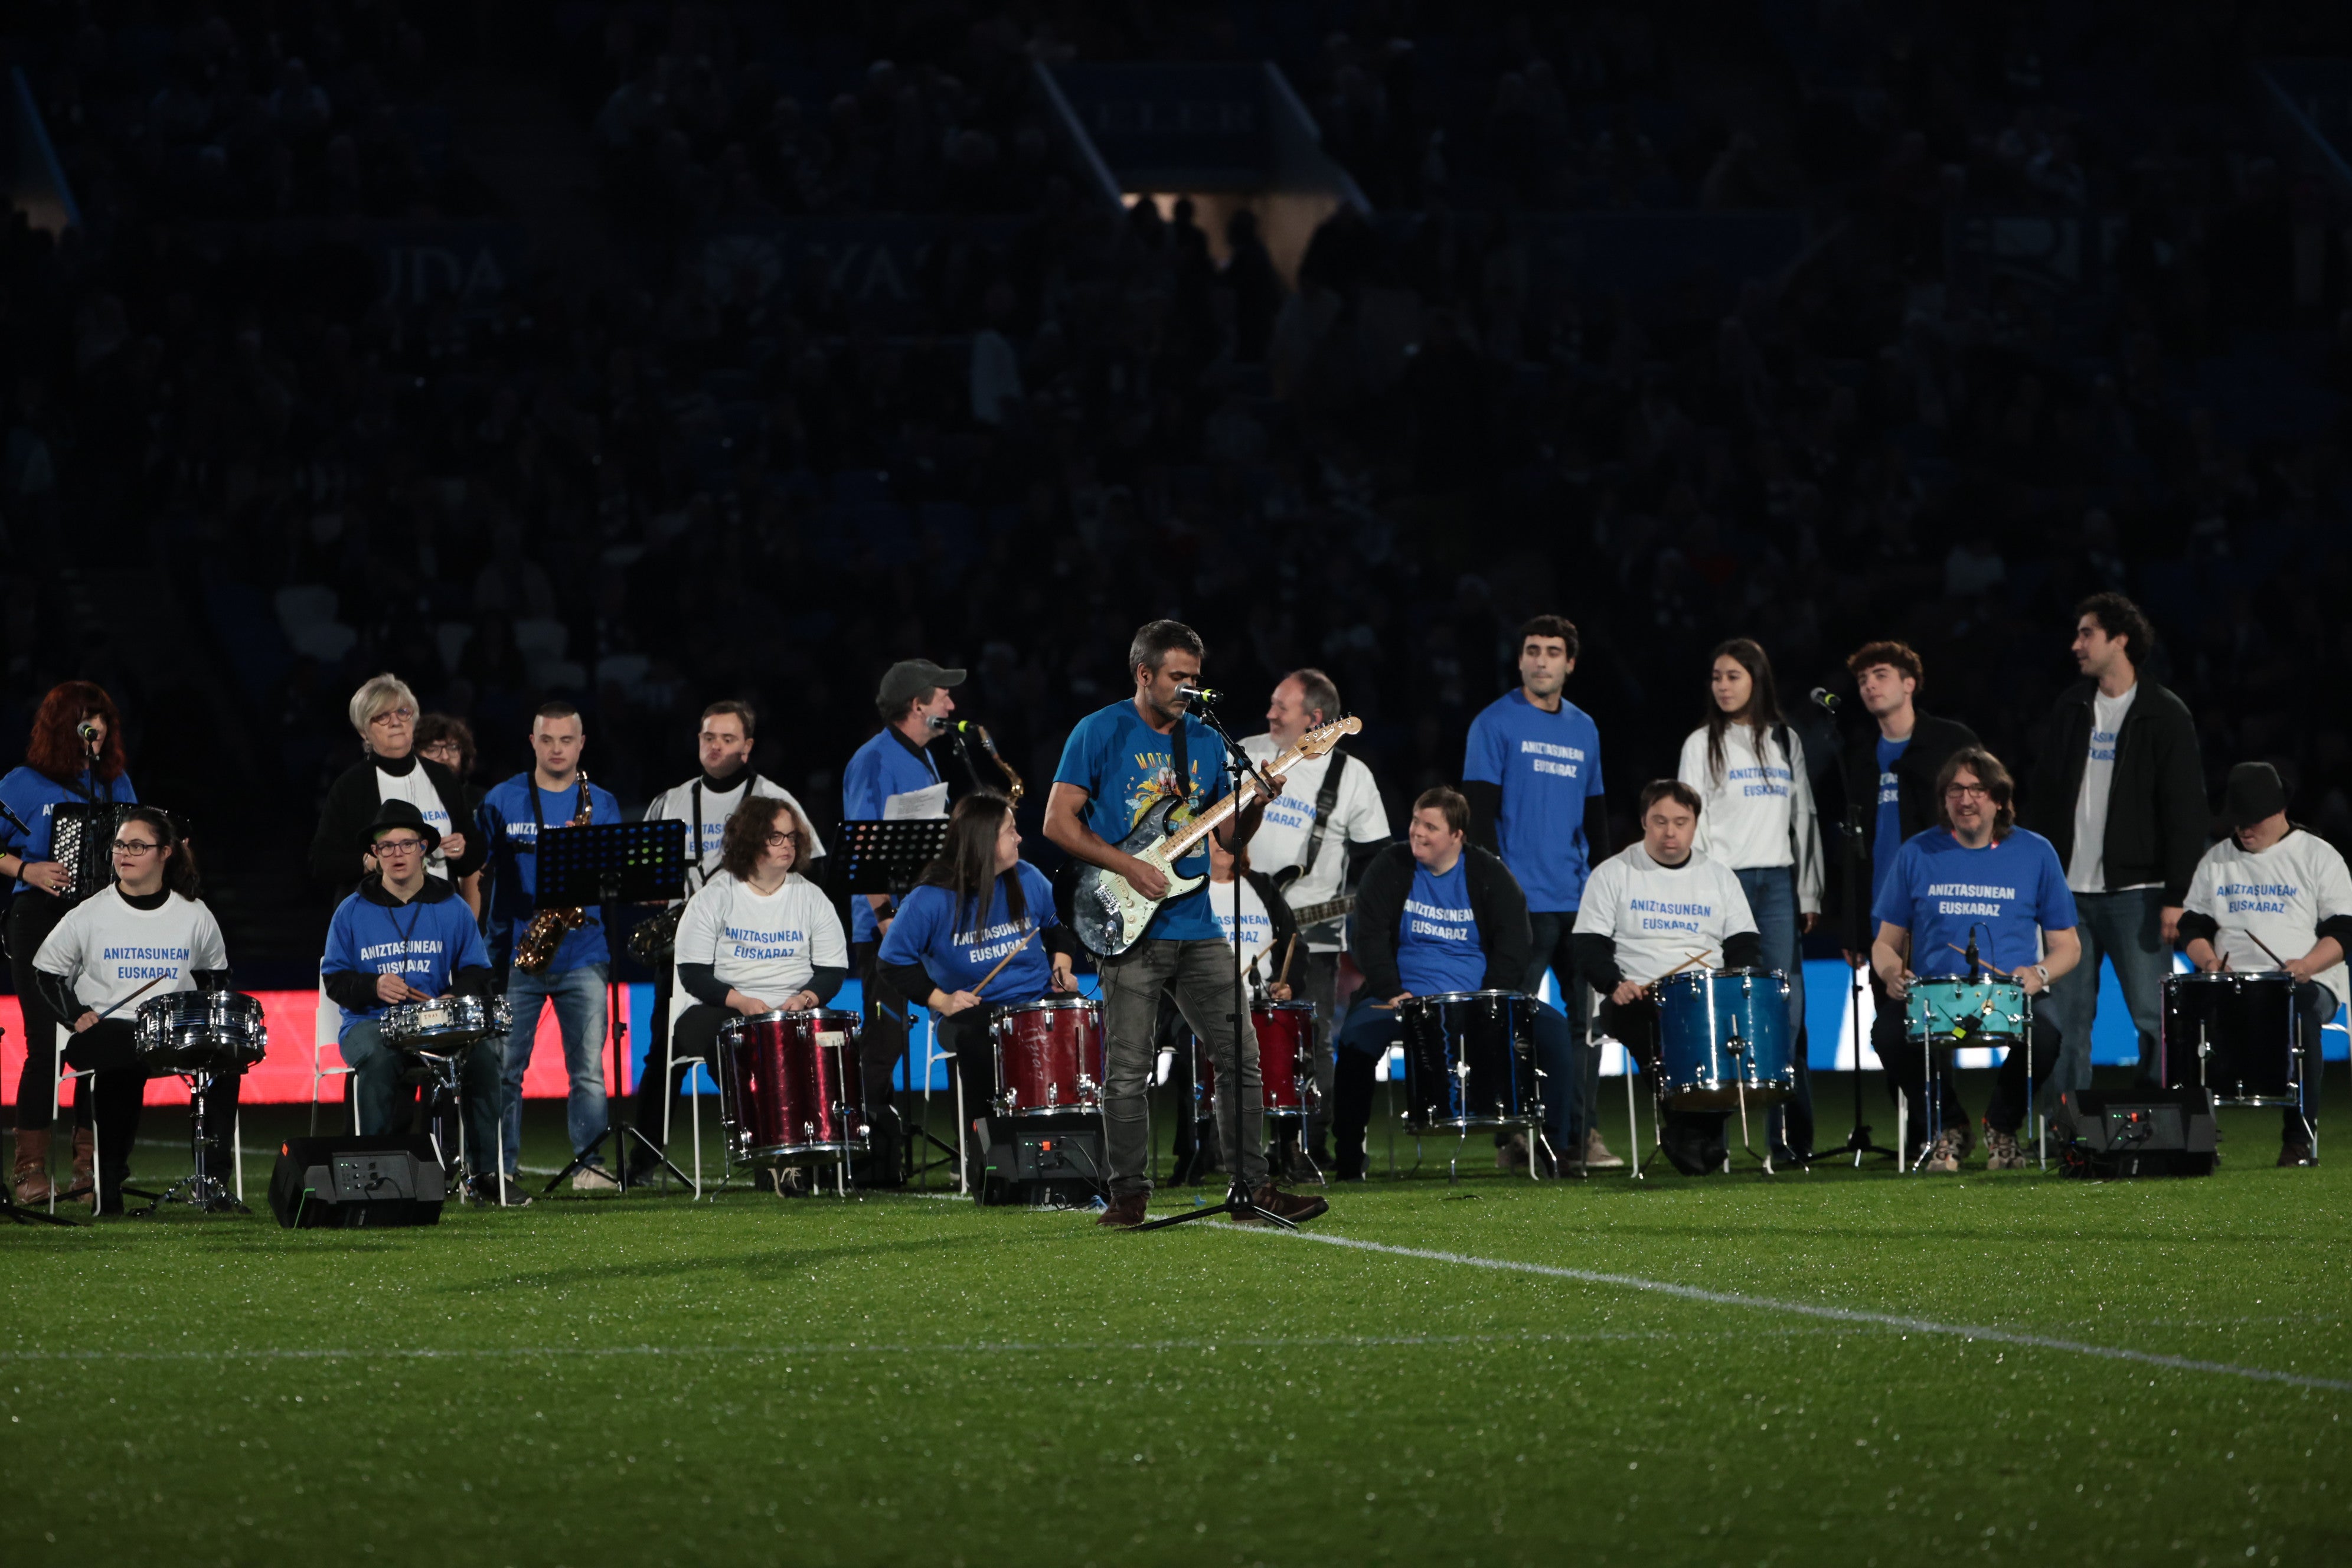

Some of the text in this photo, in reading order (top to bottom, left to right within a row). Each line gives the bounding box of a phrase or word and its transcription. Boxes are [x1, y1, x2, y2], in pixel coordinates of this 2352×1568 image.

[1928, 884, 2015, 900] ANIZTASUNEAN
[2217, 884, 2297, 897] ANIZTASUNEAN
[1630, 899, 1711, 917] ANIZTASUNEAN
[1939, 901, 2001, 917] EUSKARAZ
[2229, 900, 2285, 913] EUSKARAZ
[1411, 919, 1468, 940] EUSKARAZ
[1642, 917, 1700, 934] EUSKARAZ
[725, 926, 804, 943] ANIZTASUNEAN
[103, 947, 190, 961] ANIZTASUNEAN
[361, 940, 443, 961] ANIZTASUNEAN
[734, 945, 795, 959] EUSKARAZ
[118, 966, 178, 980] EUSKARAZ
